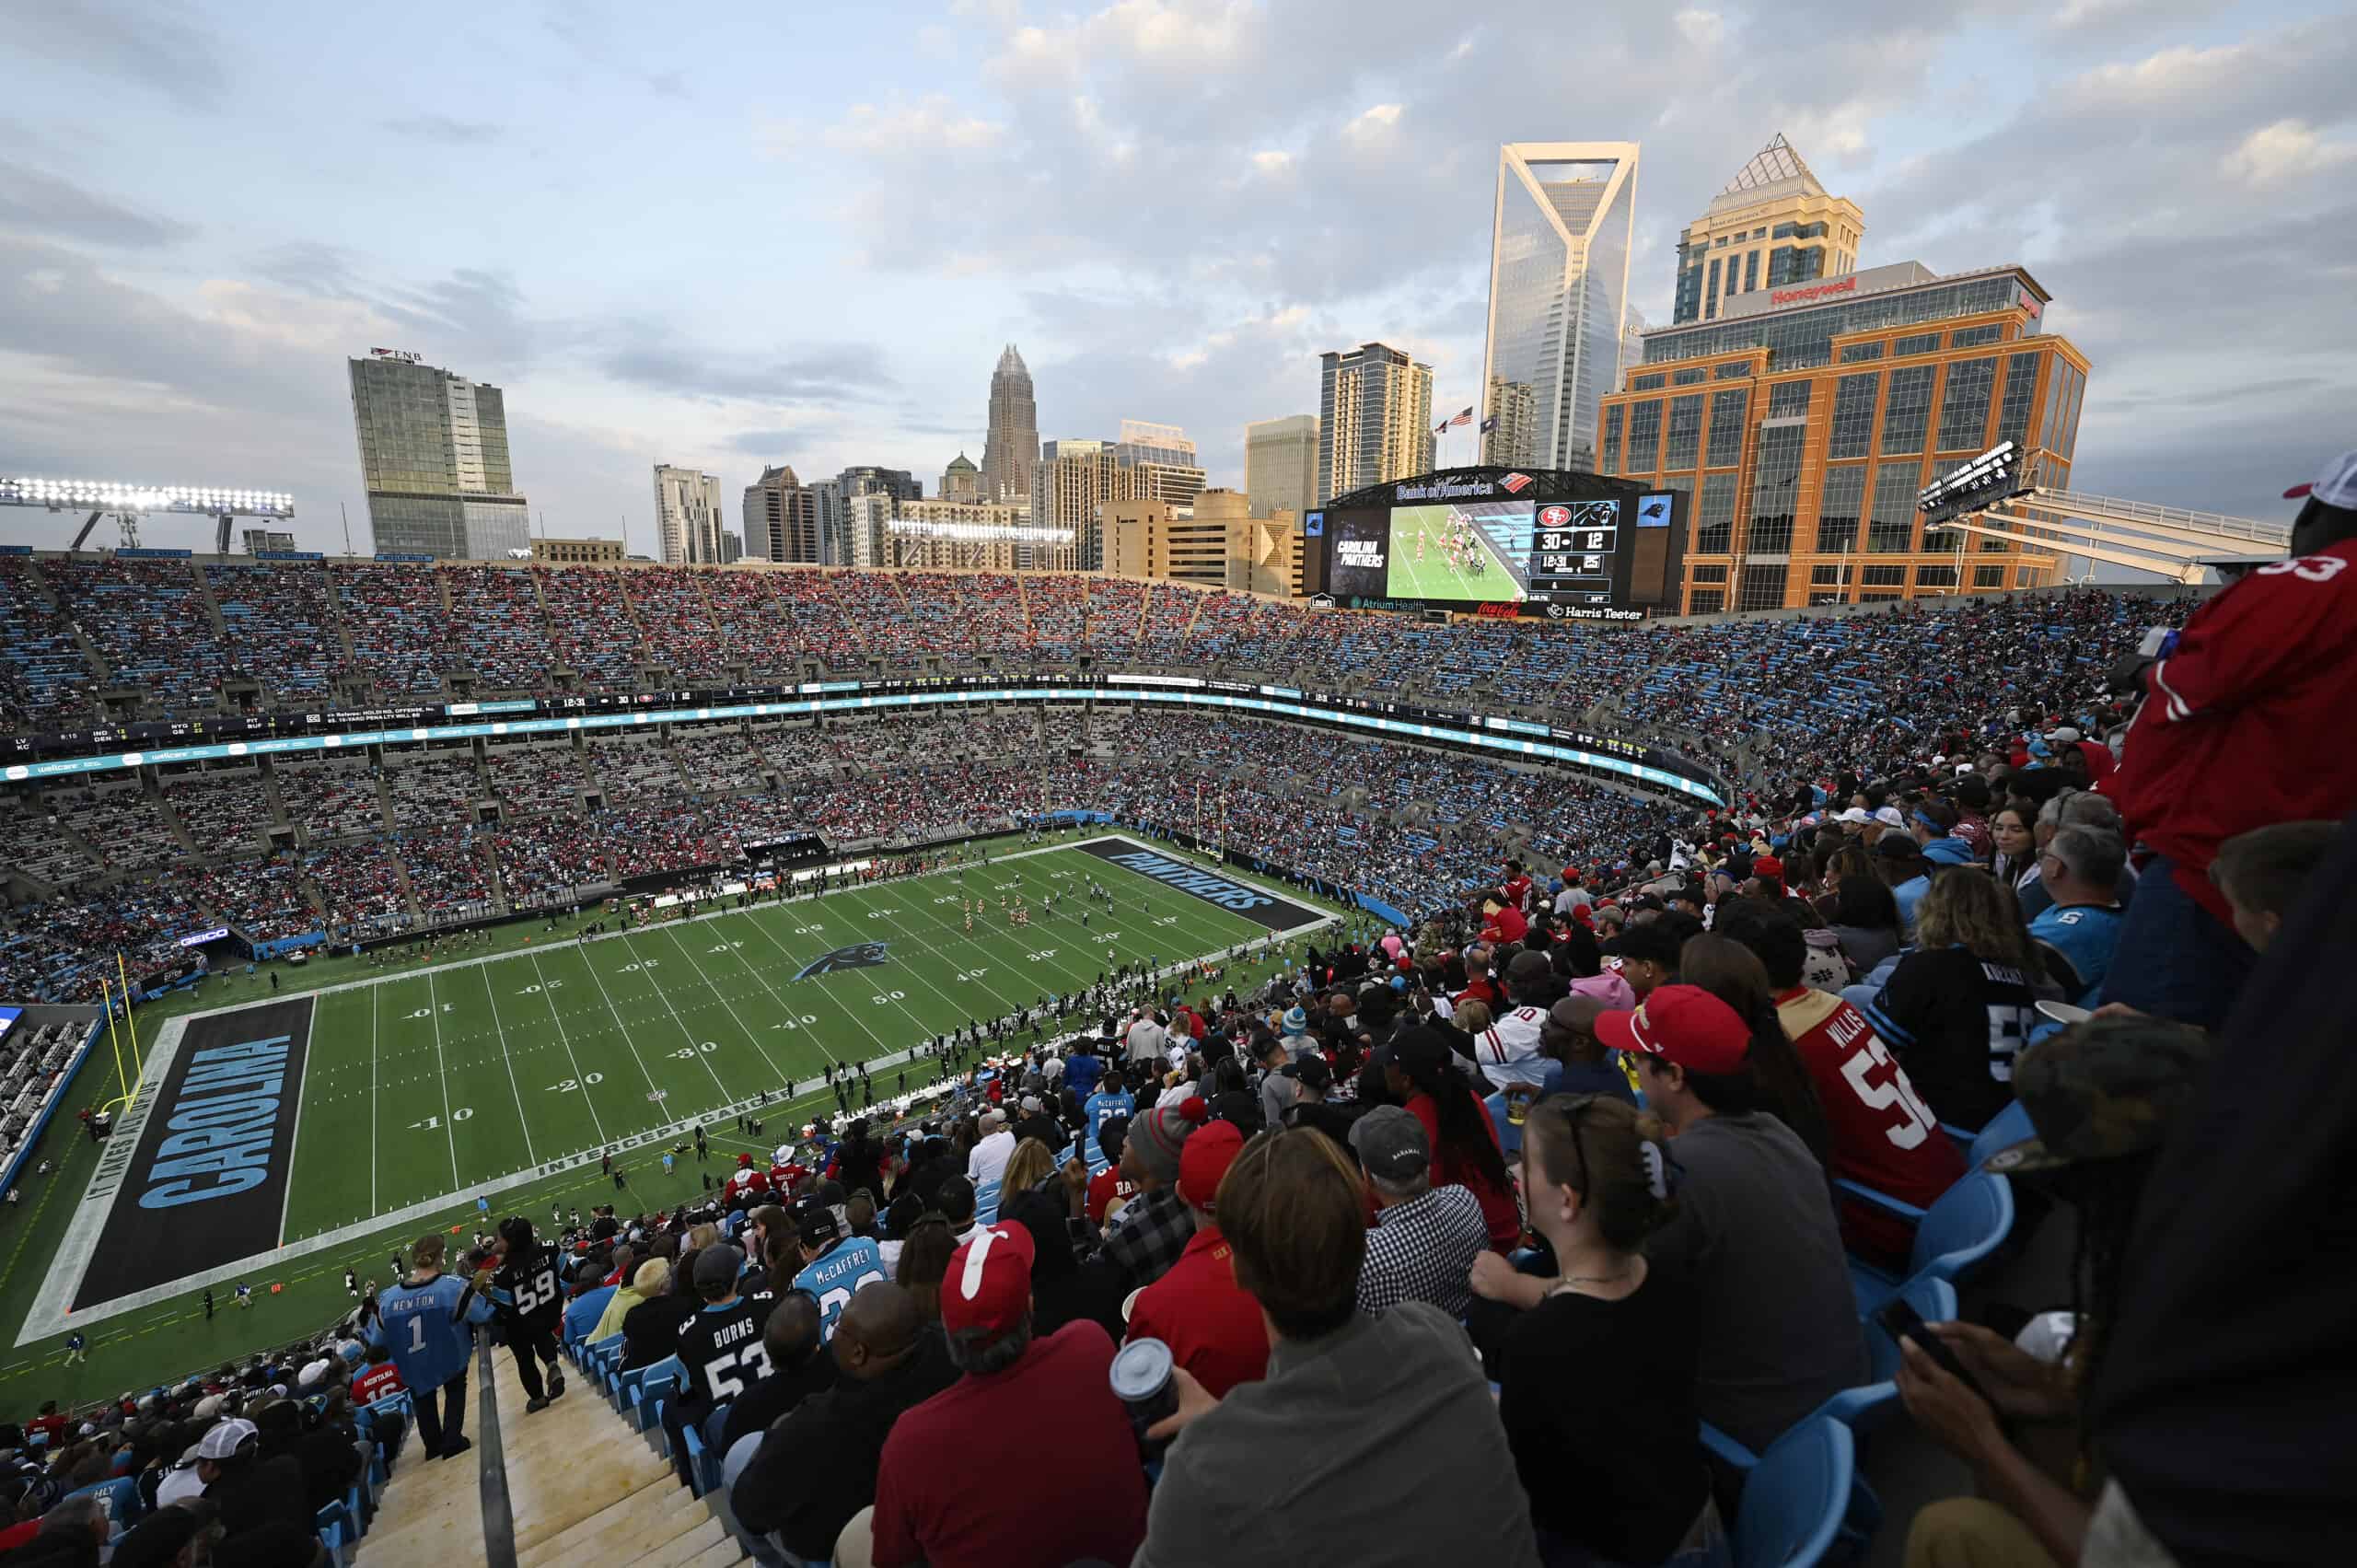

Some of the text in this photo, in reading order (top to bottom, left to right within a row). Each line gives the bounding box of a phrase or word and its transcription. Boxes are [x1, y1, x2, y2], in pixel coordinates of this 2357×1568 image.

[1772, 276, 1856, 304] Honeywell
[1397, 483, 1493, 500] Bank of America
[1337, 541, 1377, 553] CAROLINA
[1542, 532, 1603, 550] 30 12
[1341, 553, 1385, 567] PANTHERS
[1543, 556, 1566, 567] 12:31
[1363, 598, 1425, 611] Atrium Health
[1565, 607, 1642, 620] Harris Teeter
[38, 763, 78, 773] wellcare
[1107, 852, 1274, 910] PANTHERS
[180, 928, 229, 946] GEICO
[1027, 949, 1054, 962] 30
[624, 958, 659, 972] 30
[957, 968, 984, 983] 40
[526, 979, 563, 993] 20
[873, 990, 905, 1005] 50
[413, 1001, 457, 1017] 10
[782, 1015, 818, 1030] 40
[1825, 1008, 1866, 1050] WILLIS
[677, 1041, 718, 1059] 30
[560, 1072, 604, 1093] 20
[1840, 1034, 1937, 1150] 52
[138, 1035, 291, 1209] CAROLINA
[420, 1108, 474, 1131] 10
[539, 1121, 687, 1176] INTERCEPT
[96, 1139, 134, 1182] TAKES
[86, 1184, 116, 1201] IT
[780, 1181, 790, 1197] 4
[1116, 1181, 1134, 1196] RA
[815, 1249, 871, 1285] McCAFFREY
[515, 1269, 556, 1316] 59
[393, 1295, 436, 1312] NEWTON
[407, 1315, 427, 1354] 1
[713, 1318, 755, 1350] BURNS
[363, 1369, 395, 1388] MONTANA
[703, 1340, 775, 1400] 53
